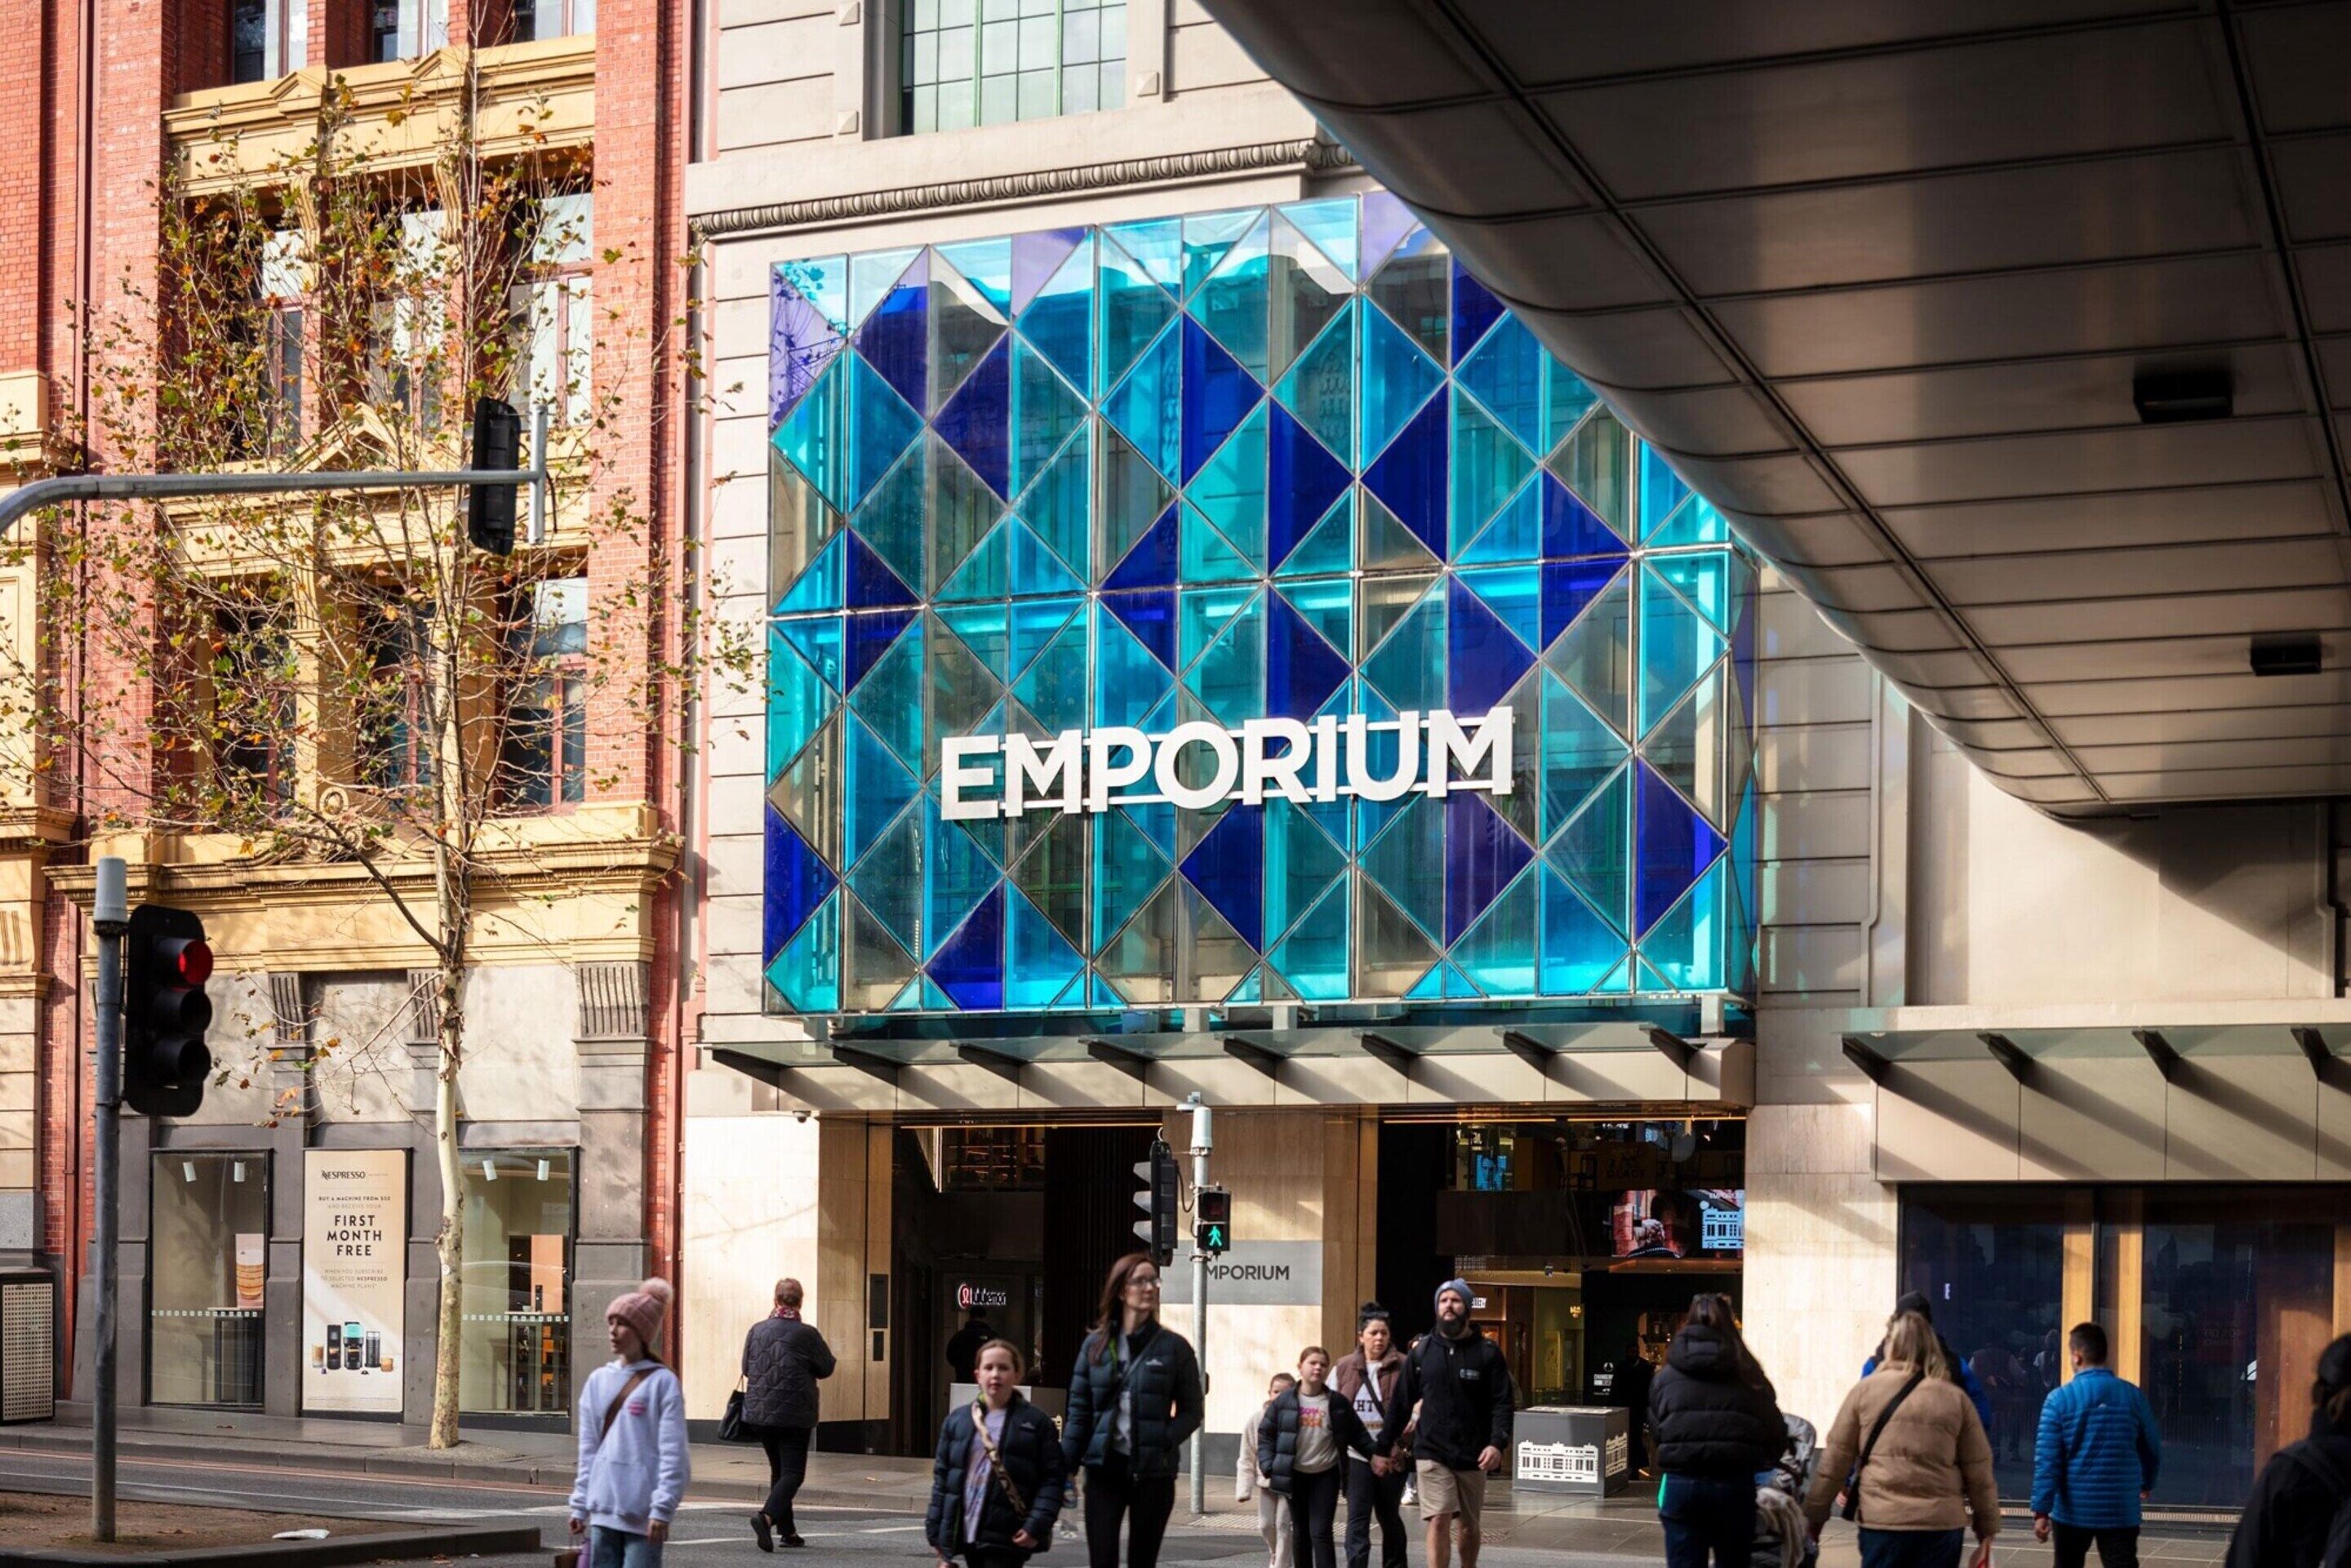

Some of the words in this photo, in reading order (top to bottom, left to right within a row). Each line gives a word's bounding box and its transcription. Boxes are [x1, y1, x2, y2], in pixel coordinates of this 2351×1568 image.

[940, 705, 1513, 820] EMPORIUM
[321, 1170, 366, 1180] NESPRESSO
[334, 1215, 376, 1226] FIRST
[327, 1229, 382, 1242] MONTH
[336, 1244, 372, 1256] FREE
[1207, 1264, 1290, 1281] MPORIUM
